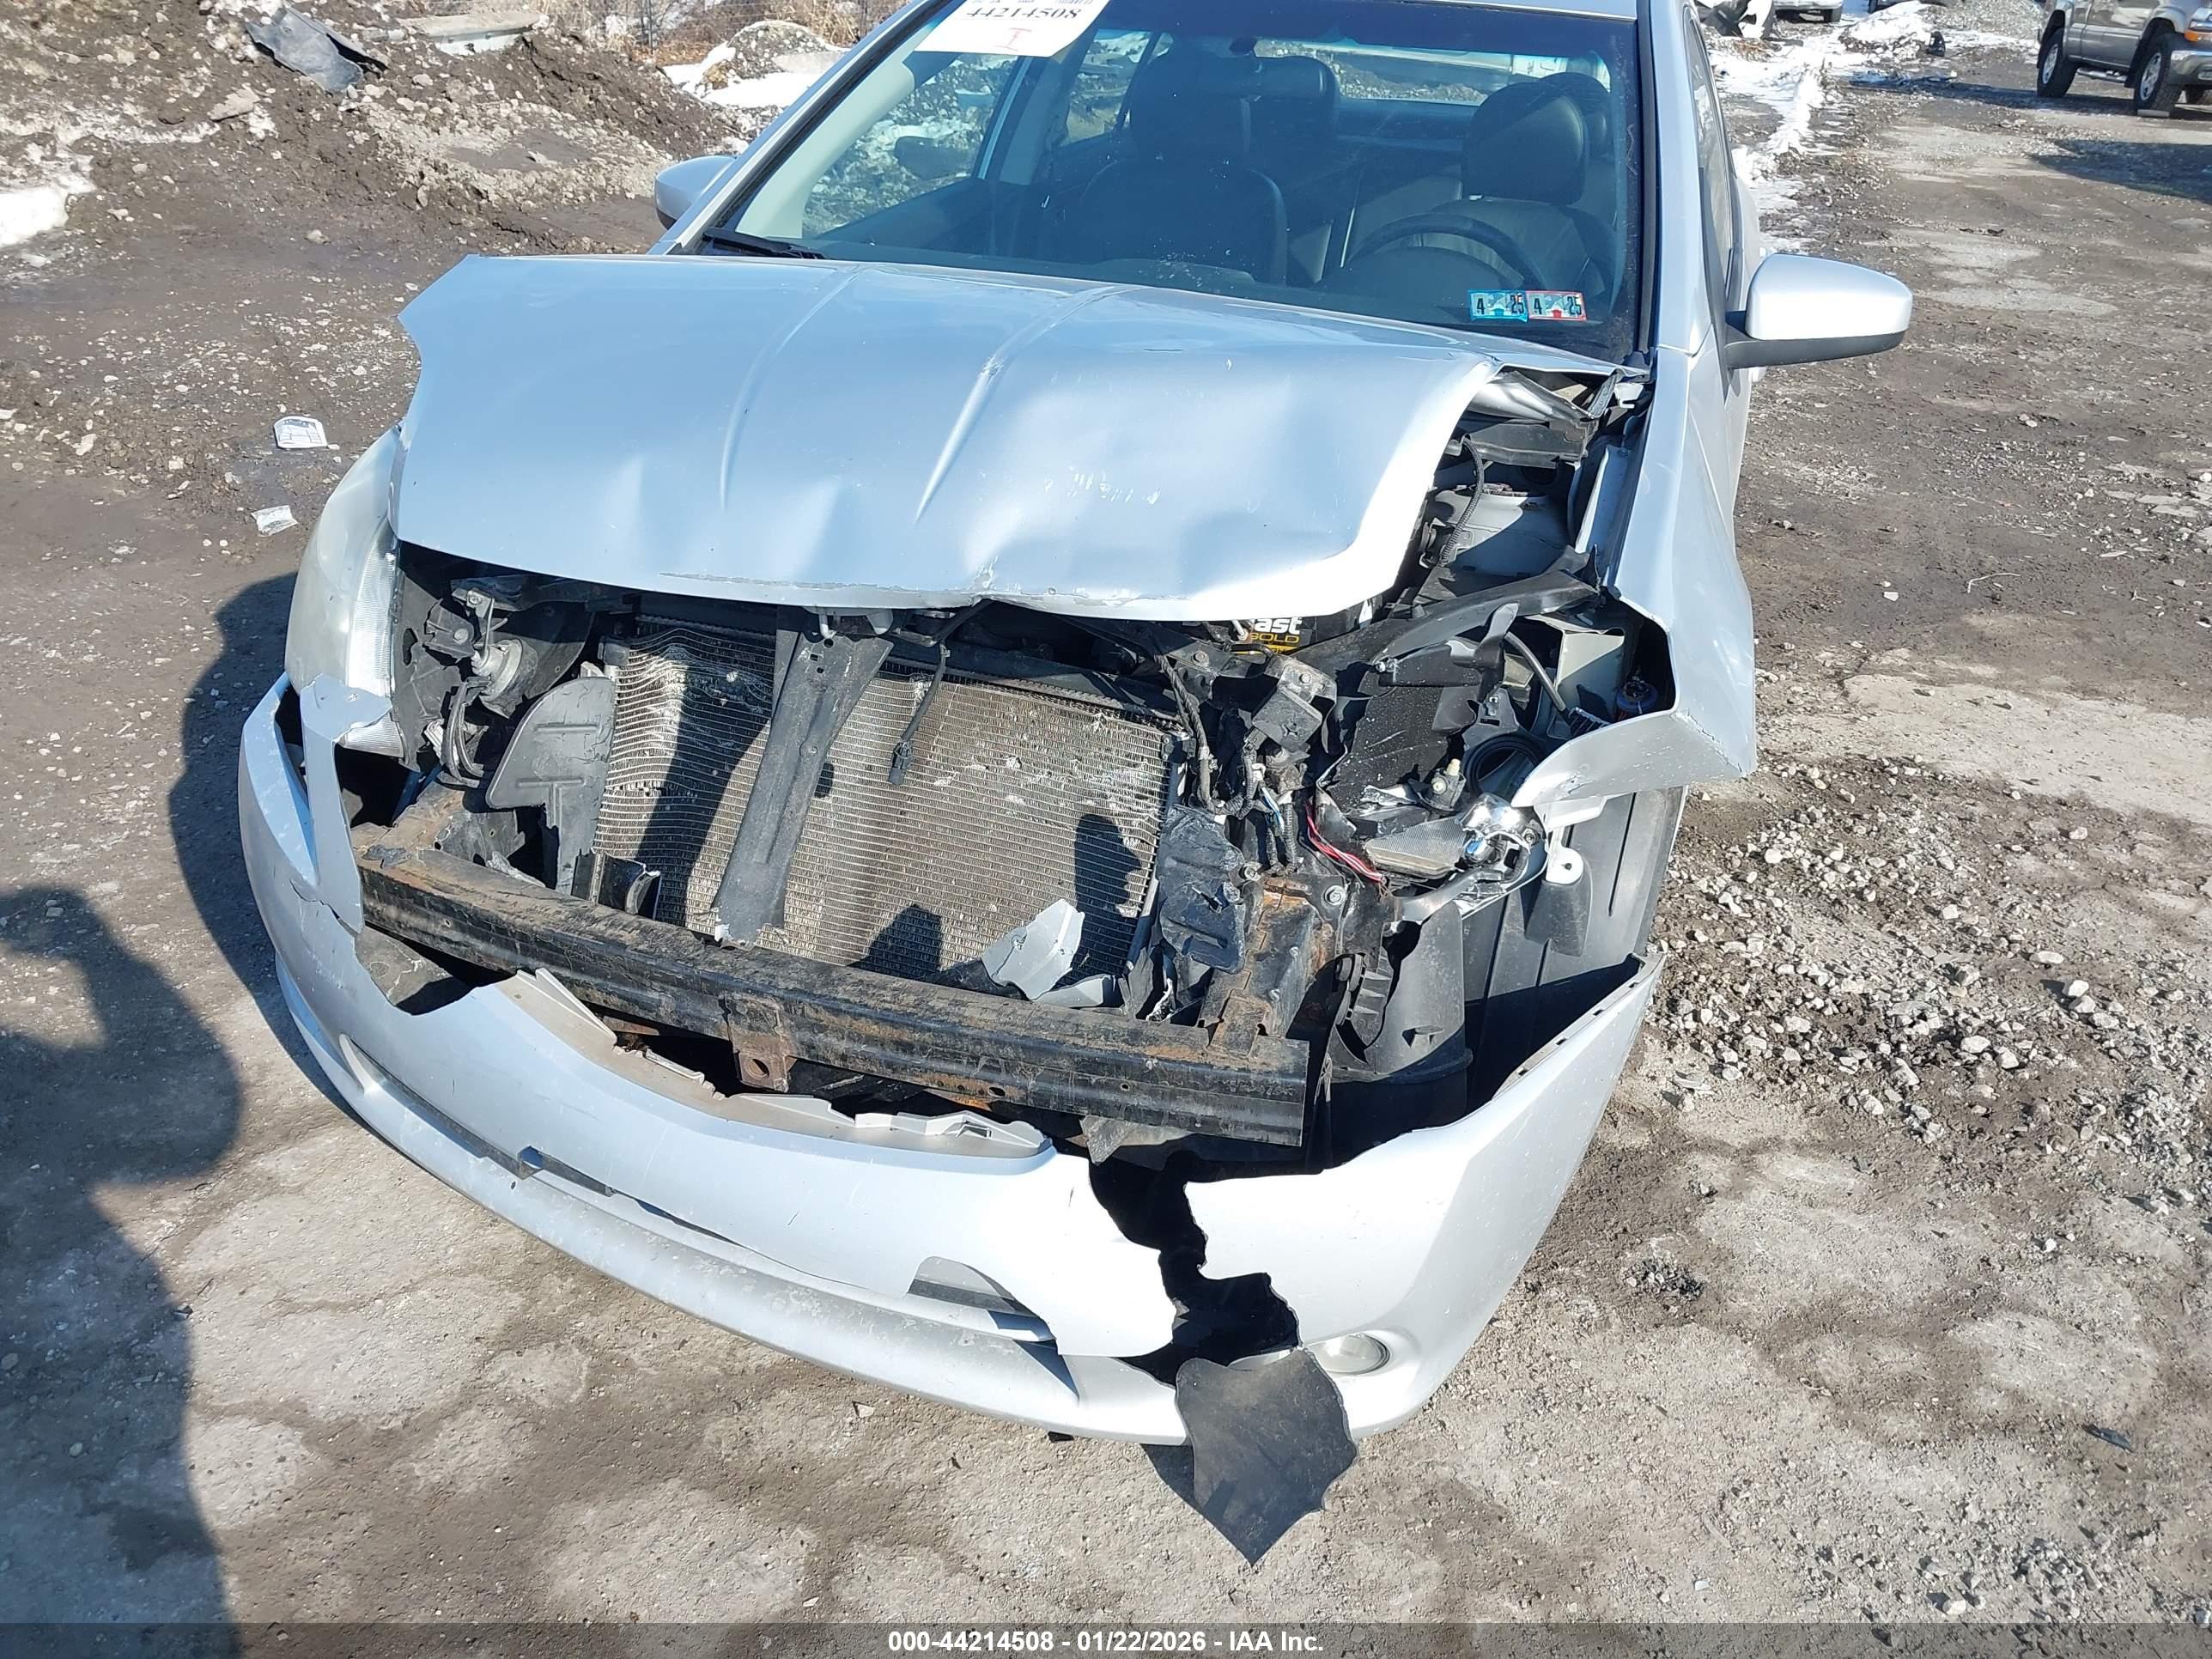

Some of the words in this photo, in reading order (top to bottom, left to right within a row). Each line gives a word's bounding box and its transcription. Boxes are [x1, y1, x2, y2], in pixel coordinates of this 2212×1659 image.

[966, 8, 1082, 19] 44214508
[1476, 297, 1486, 314] 4
[1510, 295, 1525, 314] 25
[1533, 297, 1542, 314] 4
[1567, 296, 1583, 316] 25
[1253, 617, 1303, 635] ast
